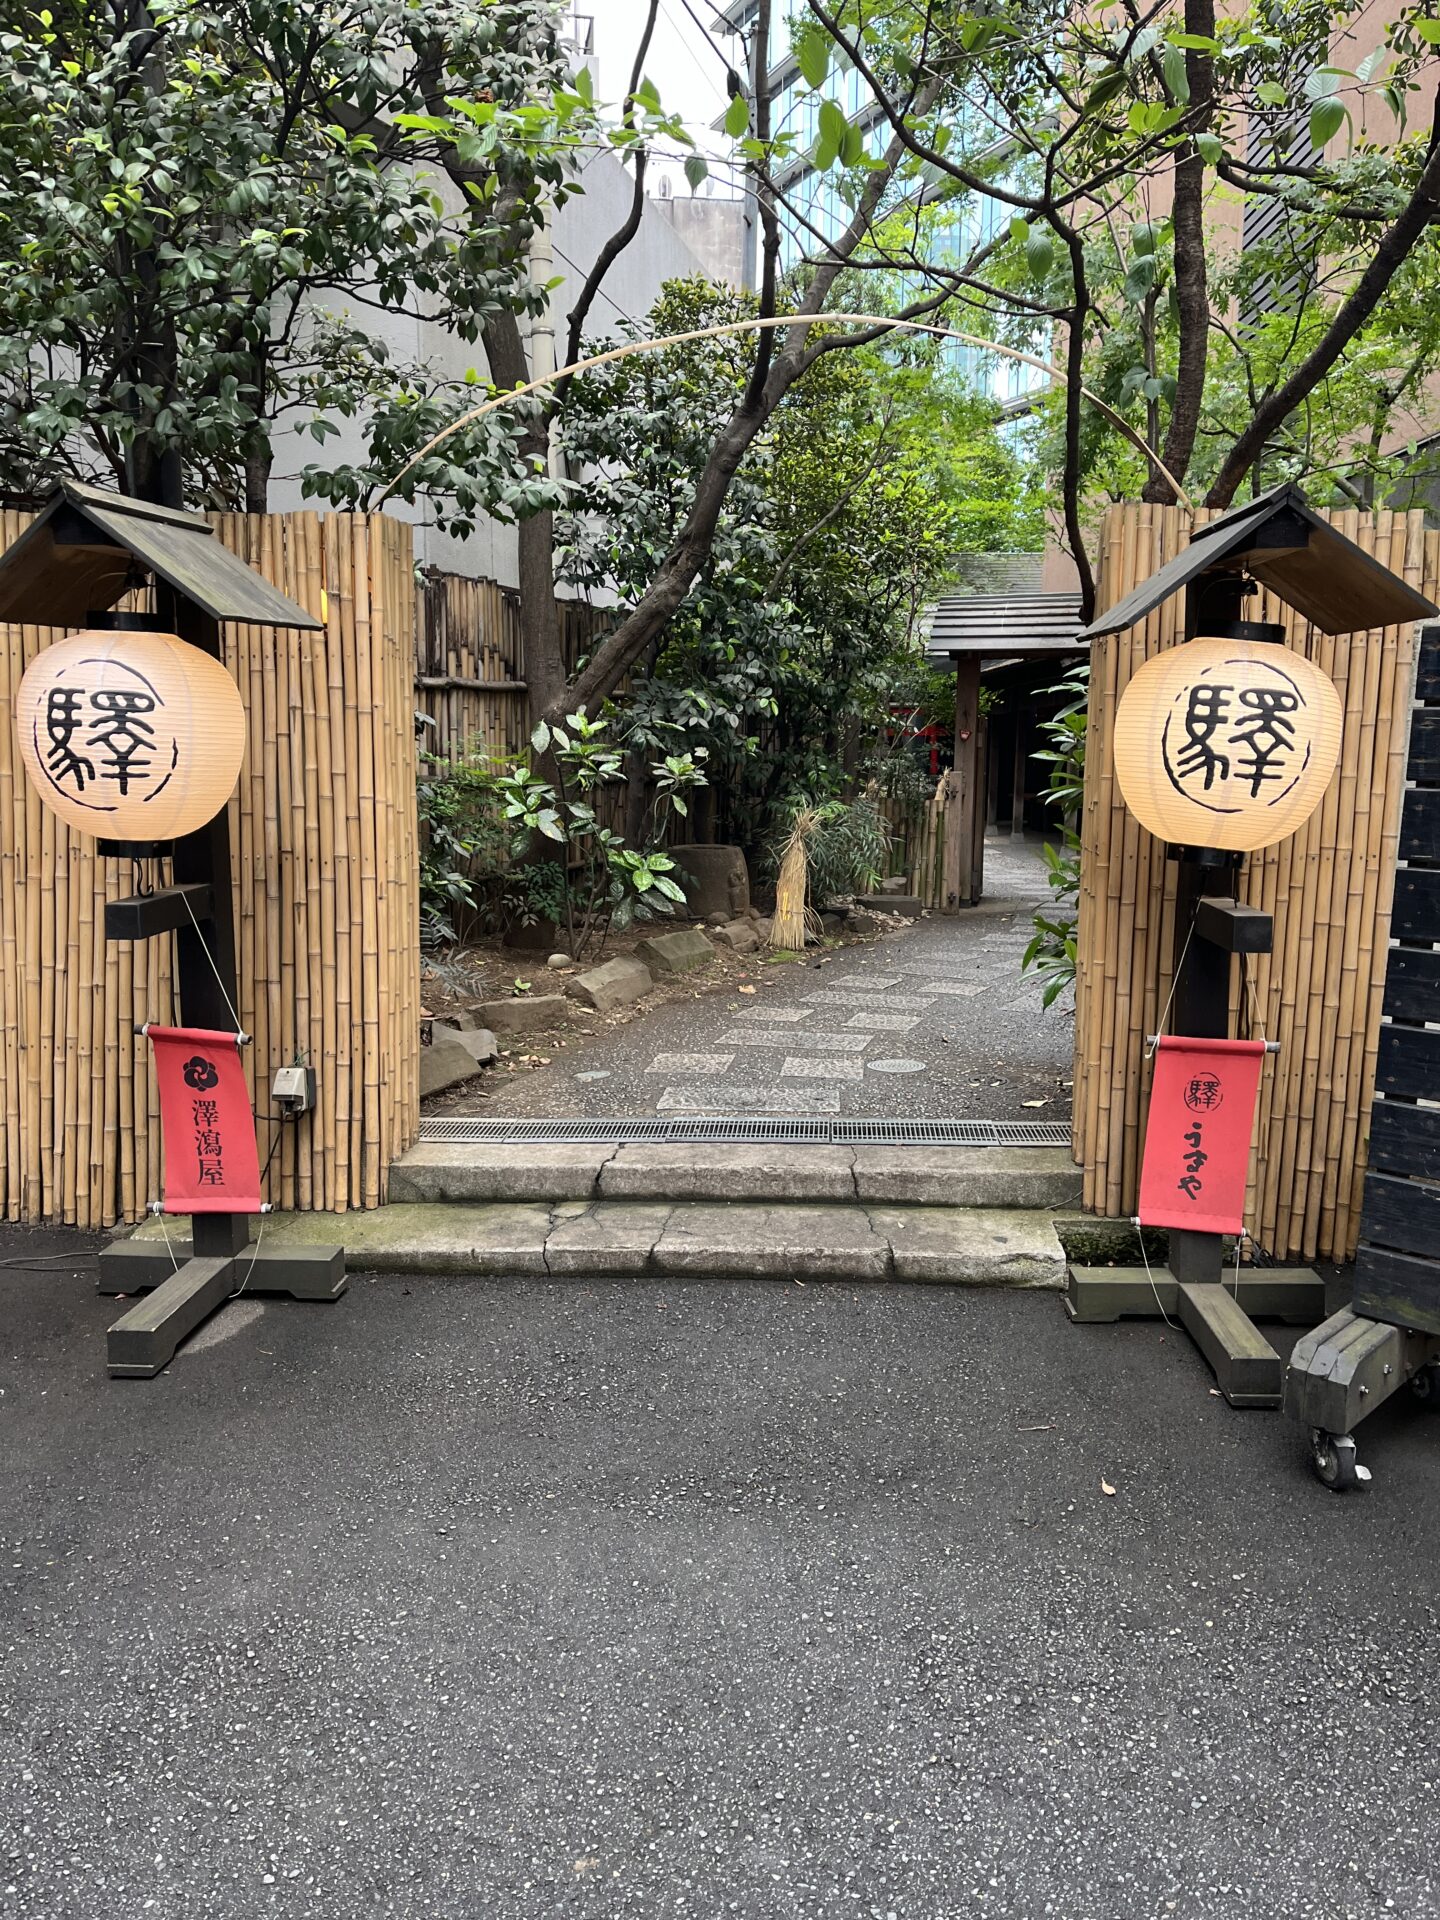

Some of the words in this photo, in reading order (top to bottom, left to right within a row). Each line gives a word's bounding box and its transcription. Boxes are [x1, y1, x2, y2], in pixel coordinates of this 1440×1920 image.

[192, 1099, 226, 1186] 澤瀉屋
[1177, 1122, 1208, 1201] うまや
